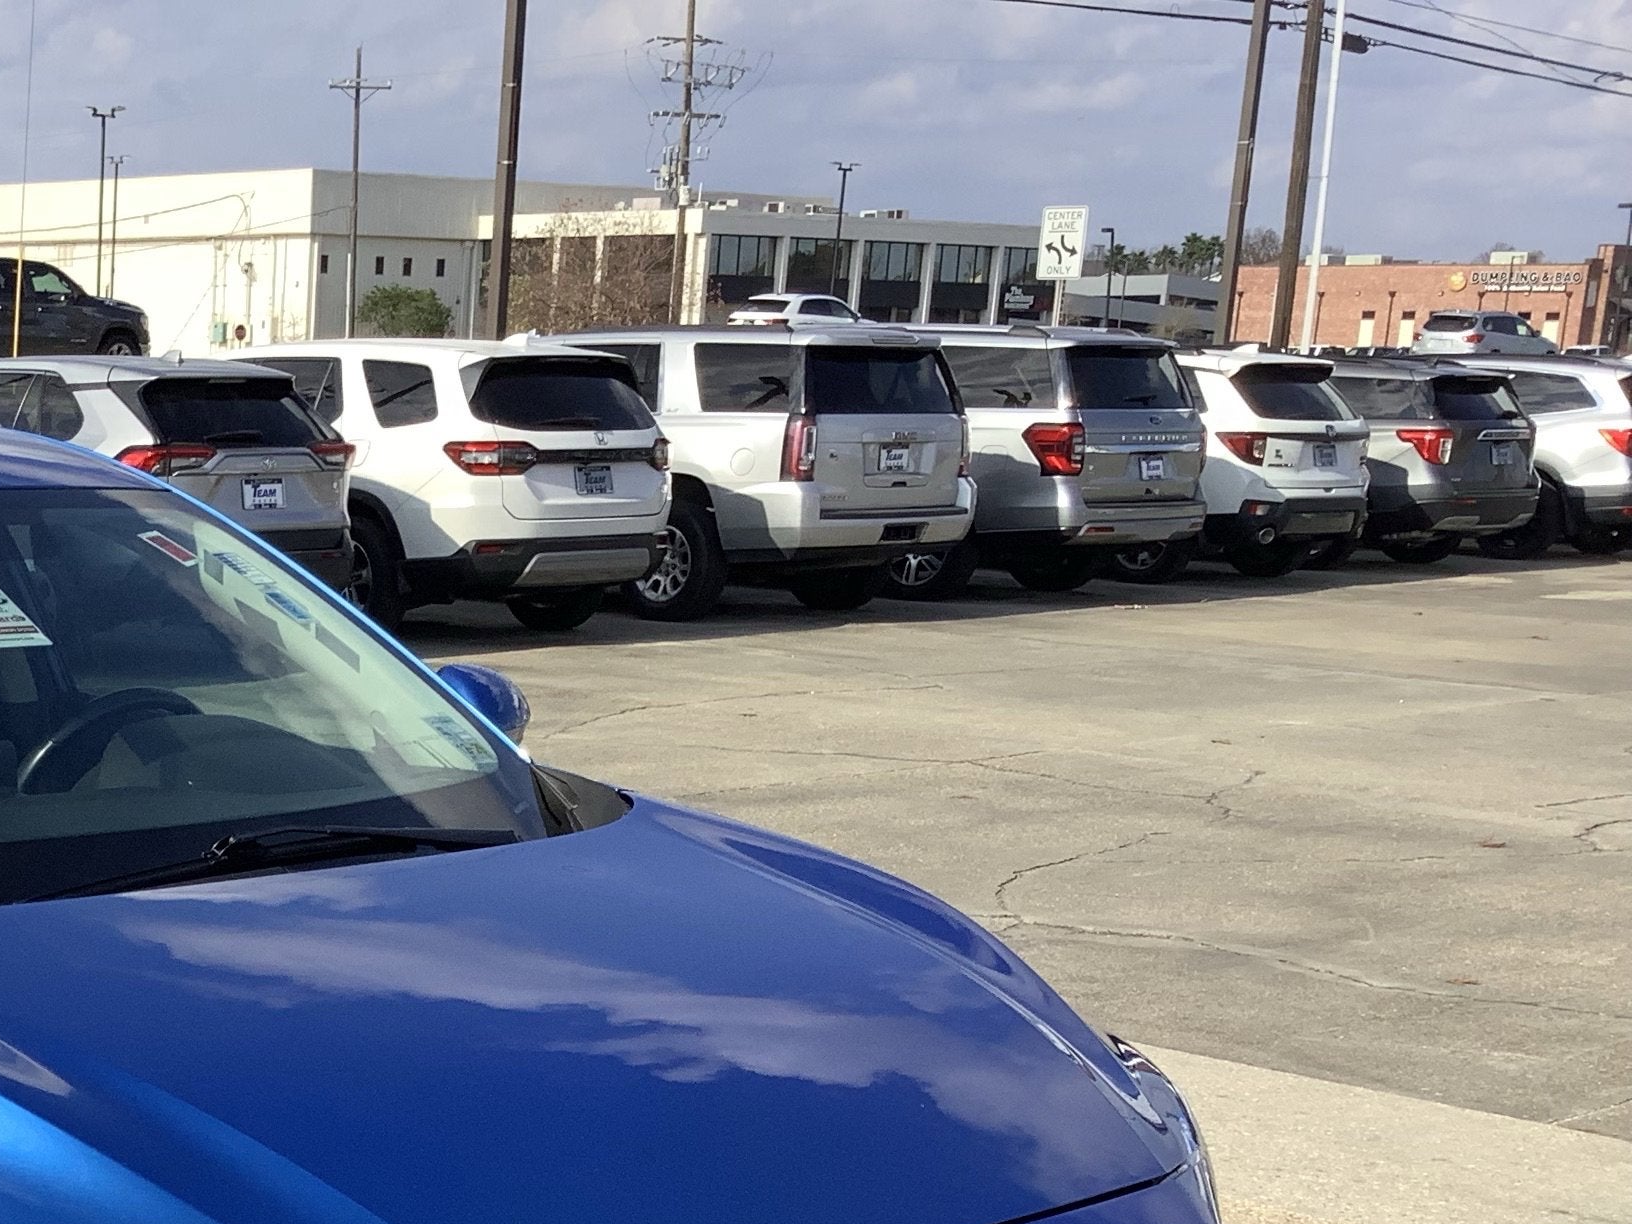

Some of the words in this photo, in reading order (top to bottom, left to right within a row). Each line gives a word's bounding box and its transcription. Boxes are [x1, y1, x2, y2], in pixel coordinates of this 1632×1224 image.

[1048, 211, 1083, 221] CENTER
[1051, 221, 1077, 230] LANE
[1047, 266, 1072, 275] ONLY
[1555, 272, 1582, 284] BAO
[252, 483, 277, 498] TEAM
